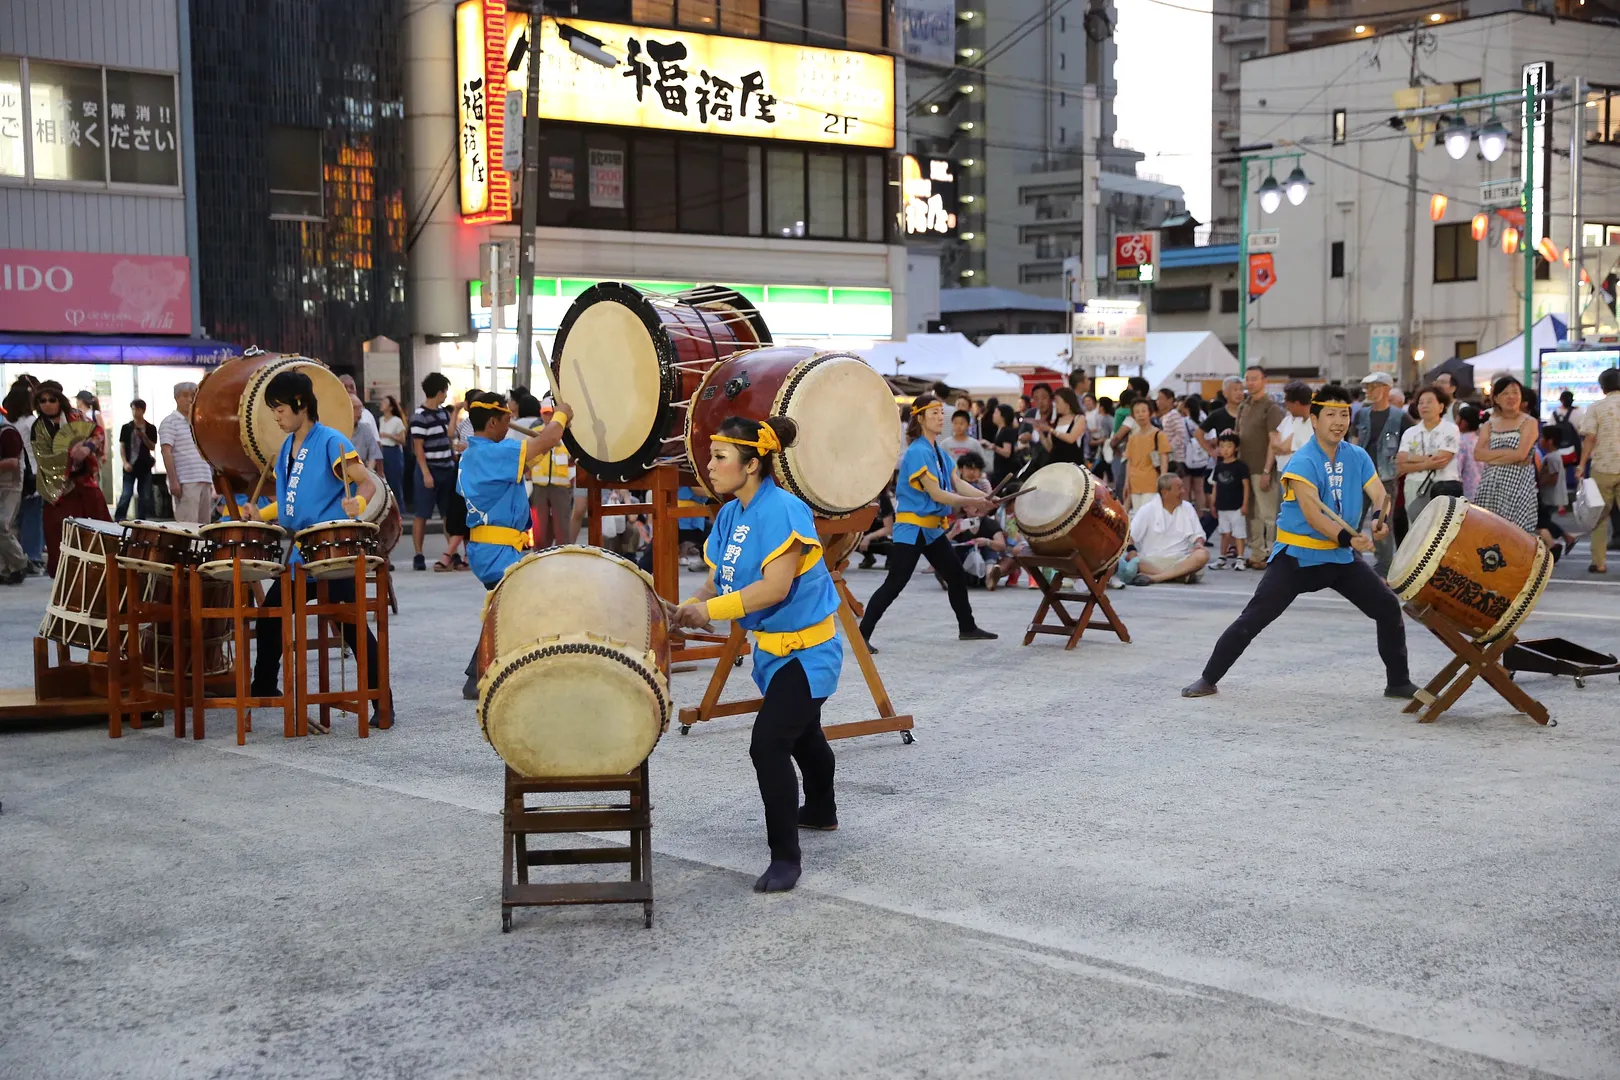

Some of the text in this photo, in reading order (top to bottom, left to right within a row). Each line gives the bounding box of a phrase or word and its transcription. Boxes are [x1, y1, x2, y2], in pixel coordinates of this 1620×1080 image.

[2, 116, 175, 152] ご相談ください
[823, 112, 858, 135] 2F
[0, 263, 74, 293] IDO
